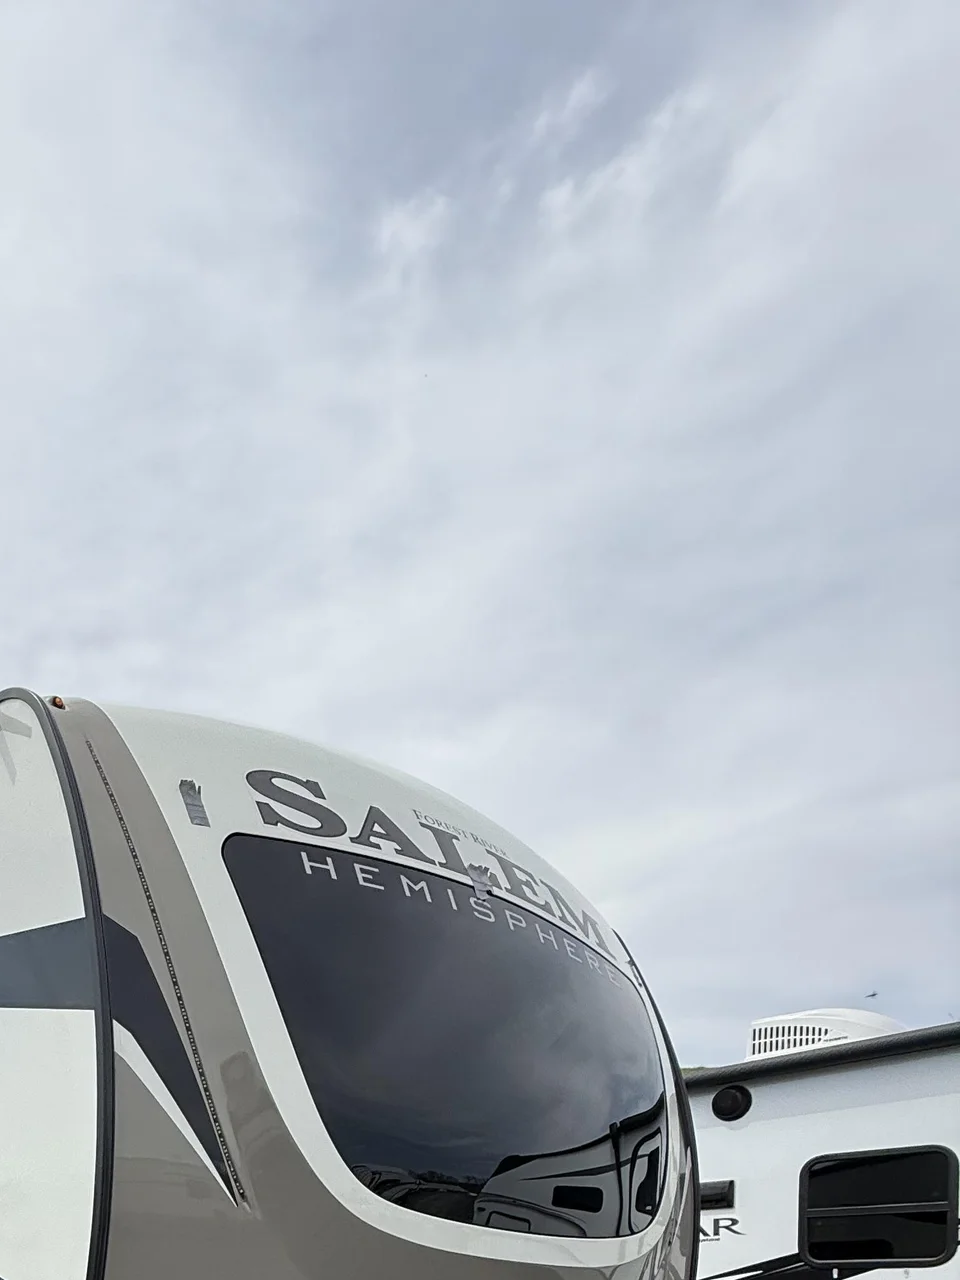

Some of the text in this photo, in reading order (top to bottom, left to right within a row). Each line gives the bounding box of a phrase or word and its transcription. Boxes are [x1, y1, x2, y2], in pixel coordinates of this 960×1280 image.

[245, 769, 617, 961] SALEM
[411, 808, 509, 858] FOREST RIVER
[300, 851, 623, 989] HEMISPHERE
